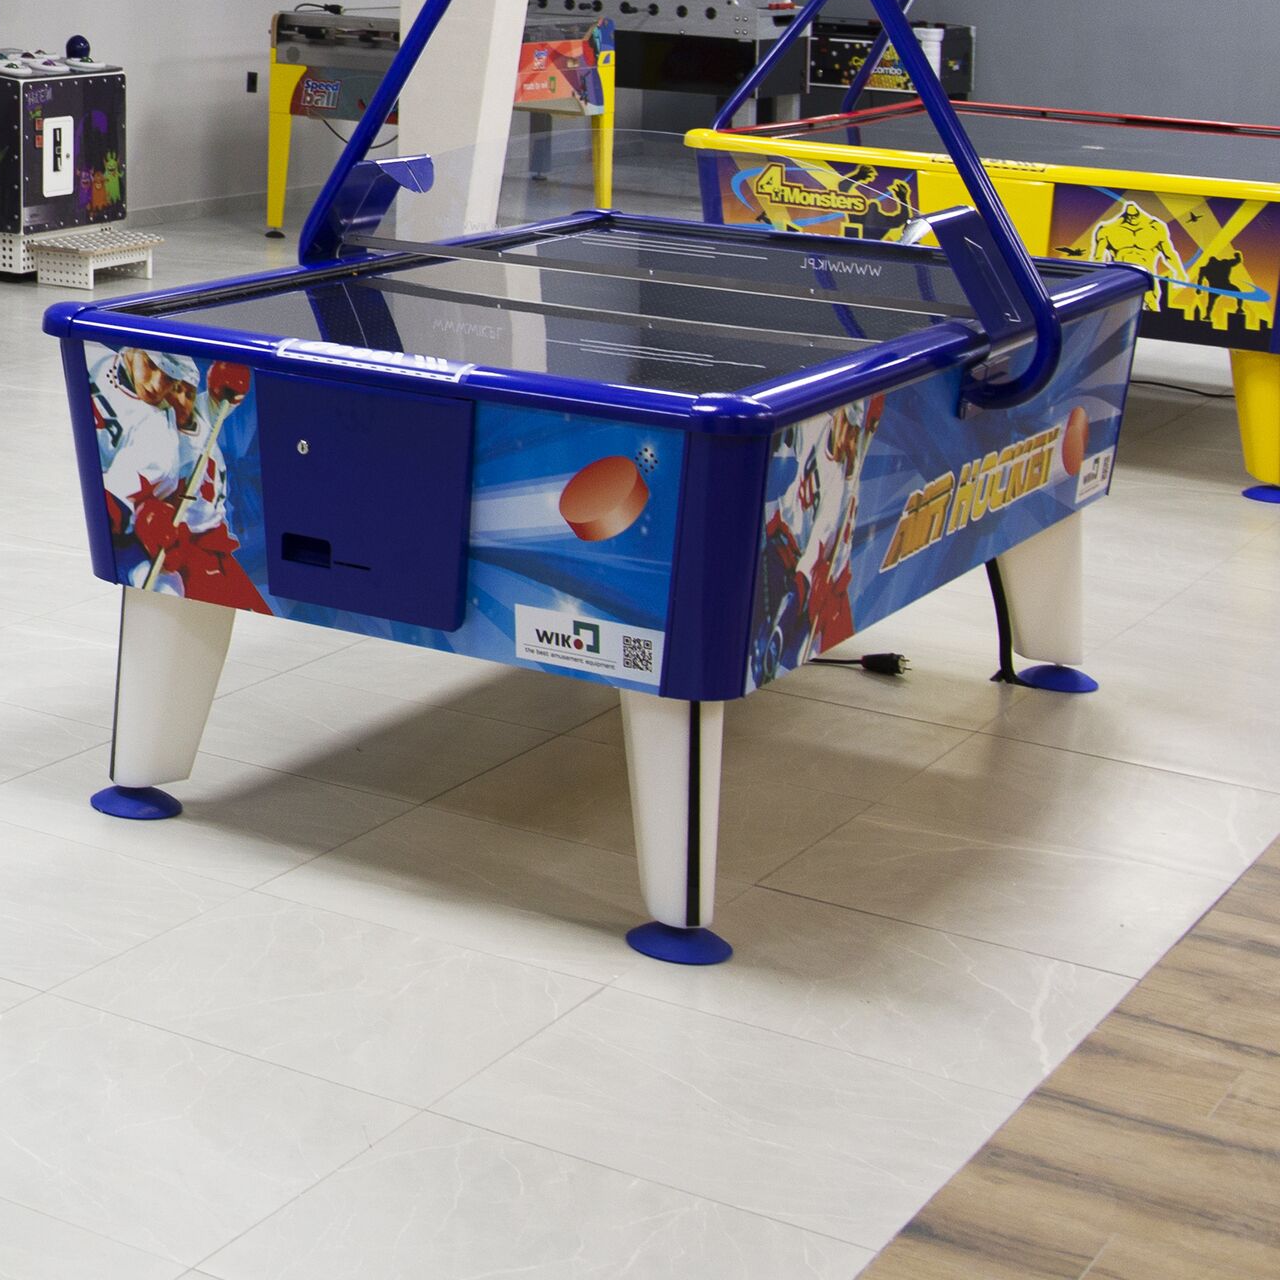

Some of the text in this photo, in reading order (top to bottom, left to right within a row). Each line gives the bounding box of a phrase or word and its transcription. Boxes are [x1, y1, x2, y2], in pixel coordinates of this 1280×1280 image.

[304, 78, 340, 92] Speed
[302, 88, 338, 107] ball
[879, 423, 1063, 574] AIR HOCKEY
[535, 628, 572, 649] WIK
